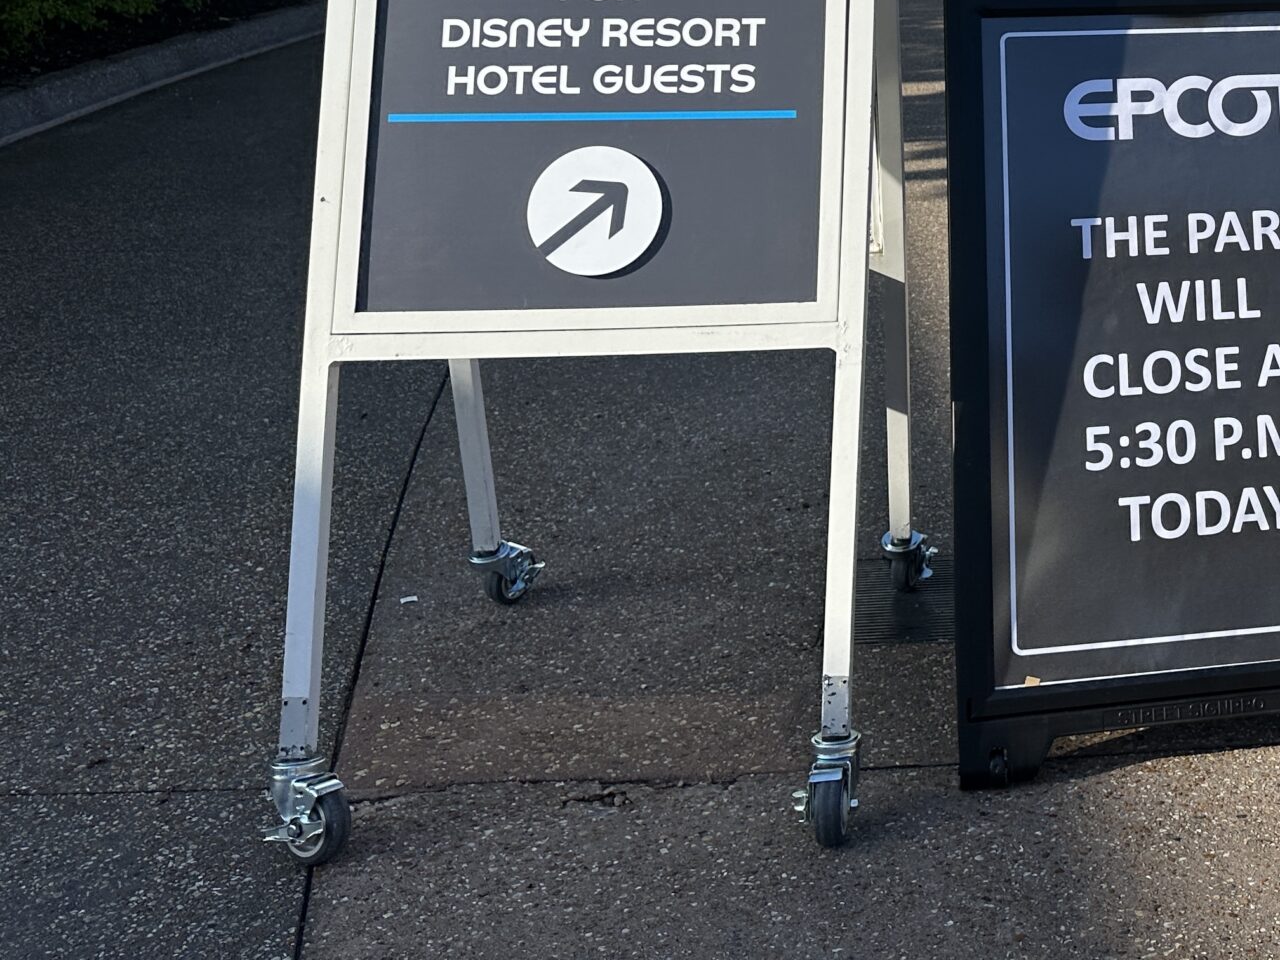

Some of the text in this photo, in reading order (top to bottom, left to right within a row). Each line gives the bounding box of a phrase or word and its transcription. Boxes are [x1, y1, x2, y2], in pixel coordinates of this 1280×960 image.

[441, 17, 767, 49] DISNEY RESORT
[446, 63, 757, 96] HOTEL GUESTS
[1070, 214, 1171, 260] THE
[1135, 277, 1262, 325] WILL
[1083, 346, 1242, 399] CLOSE
[1085, 419, 1197, 472] 5:30
